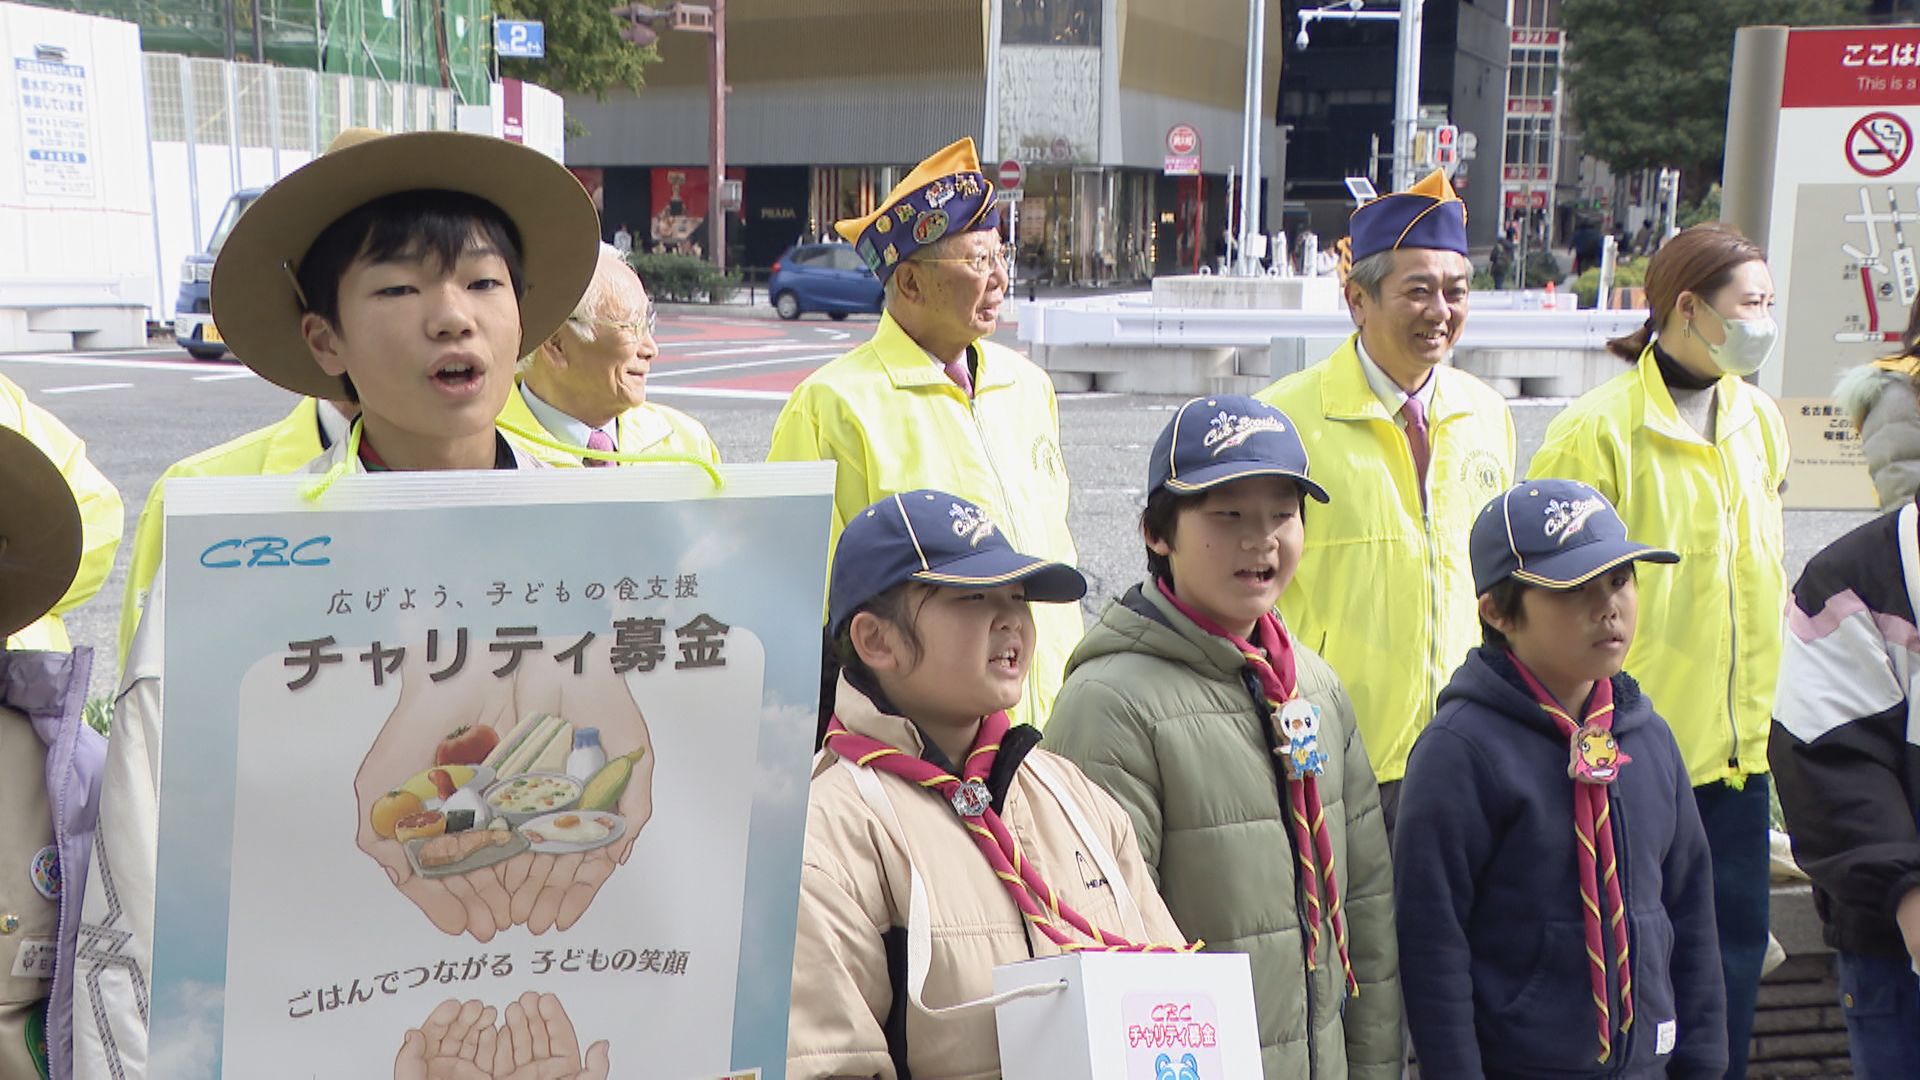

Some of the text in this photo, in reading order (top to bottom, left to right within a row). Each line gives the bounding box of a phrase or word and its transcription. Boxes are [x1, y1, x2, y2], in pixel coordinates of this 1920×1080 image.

[1841, 42, 1920, 67] ここは
[1857, 75, 1917, 91] This is a
[200, 536, 332, 568] CBC
[327, 573, 700, 616] 広げよう、子どもの食支援
[283, 613, 731, 692] チャリティ募金
[287, 947, 690, 1019] ごはんでつながる 子どもの笑顔
[1151, 1003, 1192, 1022] CBC
[1129, 1023, 1216, 1048] チャリティ募金
